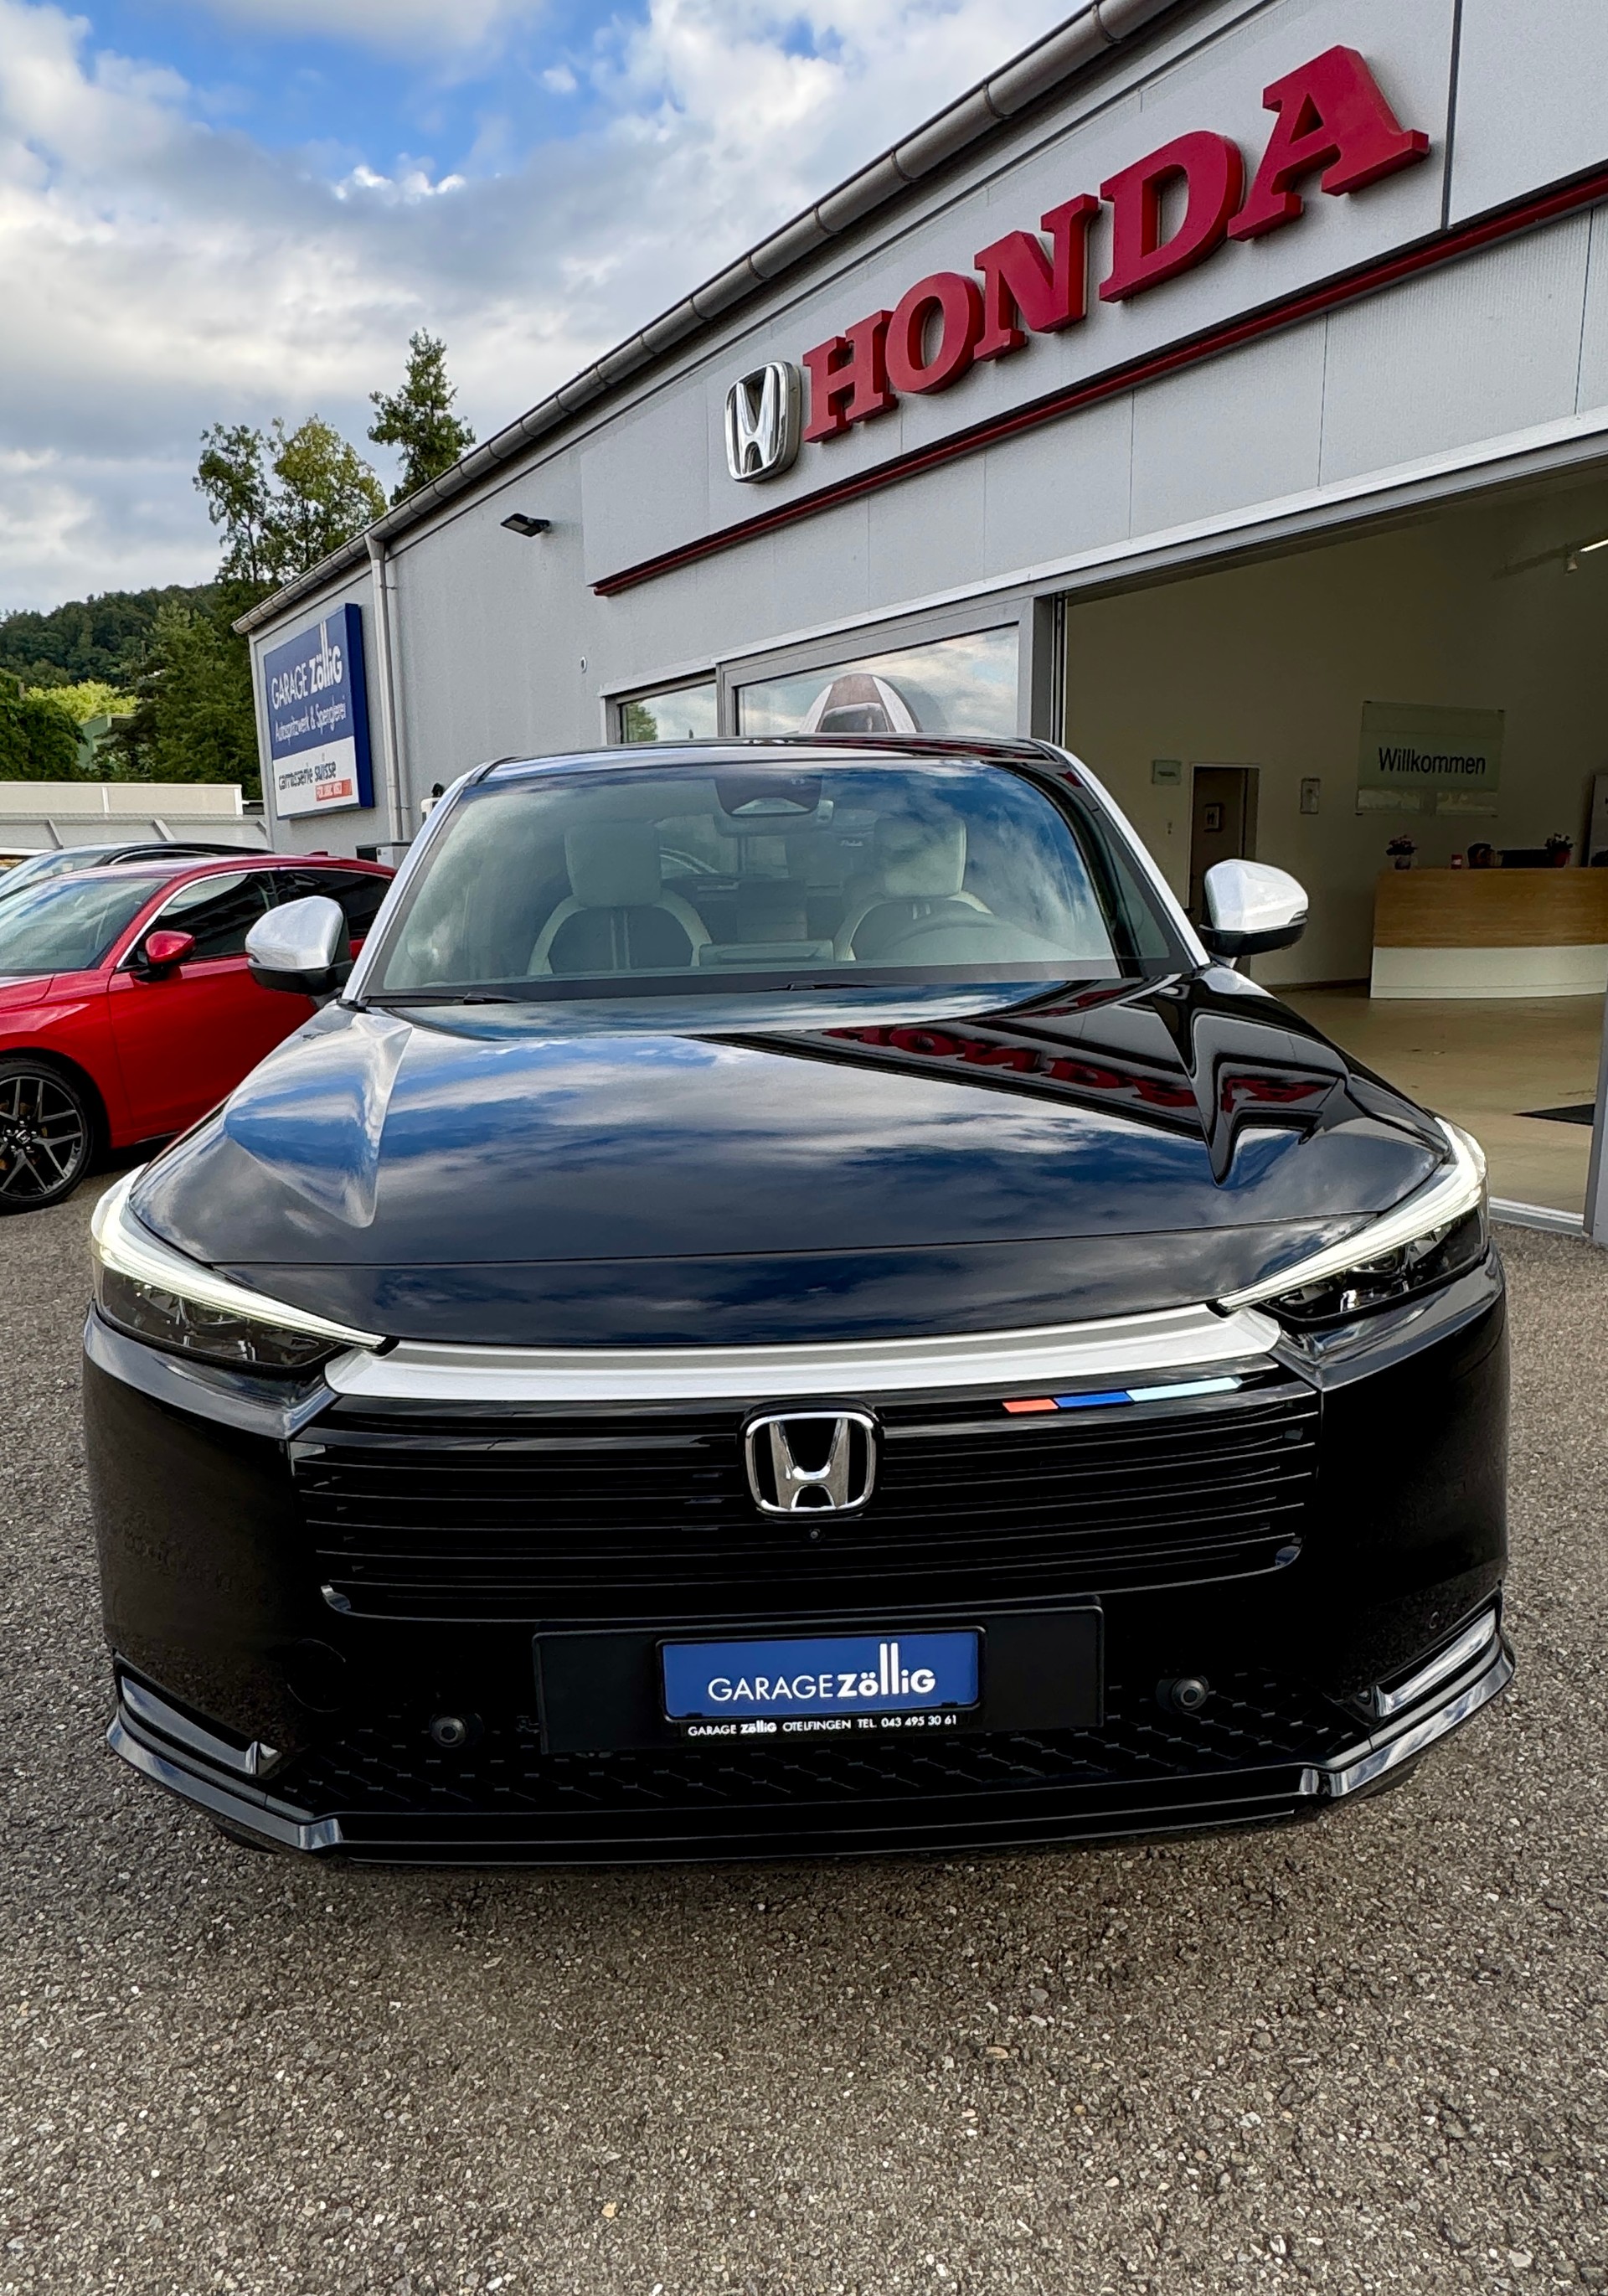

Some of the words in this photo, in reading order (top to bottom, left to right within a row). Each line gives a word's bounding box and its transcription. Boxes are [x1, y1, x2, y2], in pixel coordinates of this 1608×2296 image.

[801, 44, 1429, 443] HONDA
[271, 662, 308, 710] GARAGE
[310, 704, 316, 730] &
[1379, 747, 1487, 776] Willkommen
[708, 1674, 833, 1701] GARAGE
[688, 1724, 737, 1736] GARAGE
[782, 1719, 853, 1731] OTELFINGEN
[881, 1716, 902, 1727] 043
[904, 1716, 925, 1727] 495
[928, 1715, 942, 1726] 30
[945, 1714, 957, 1726] 61
